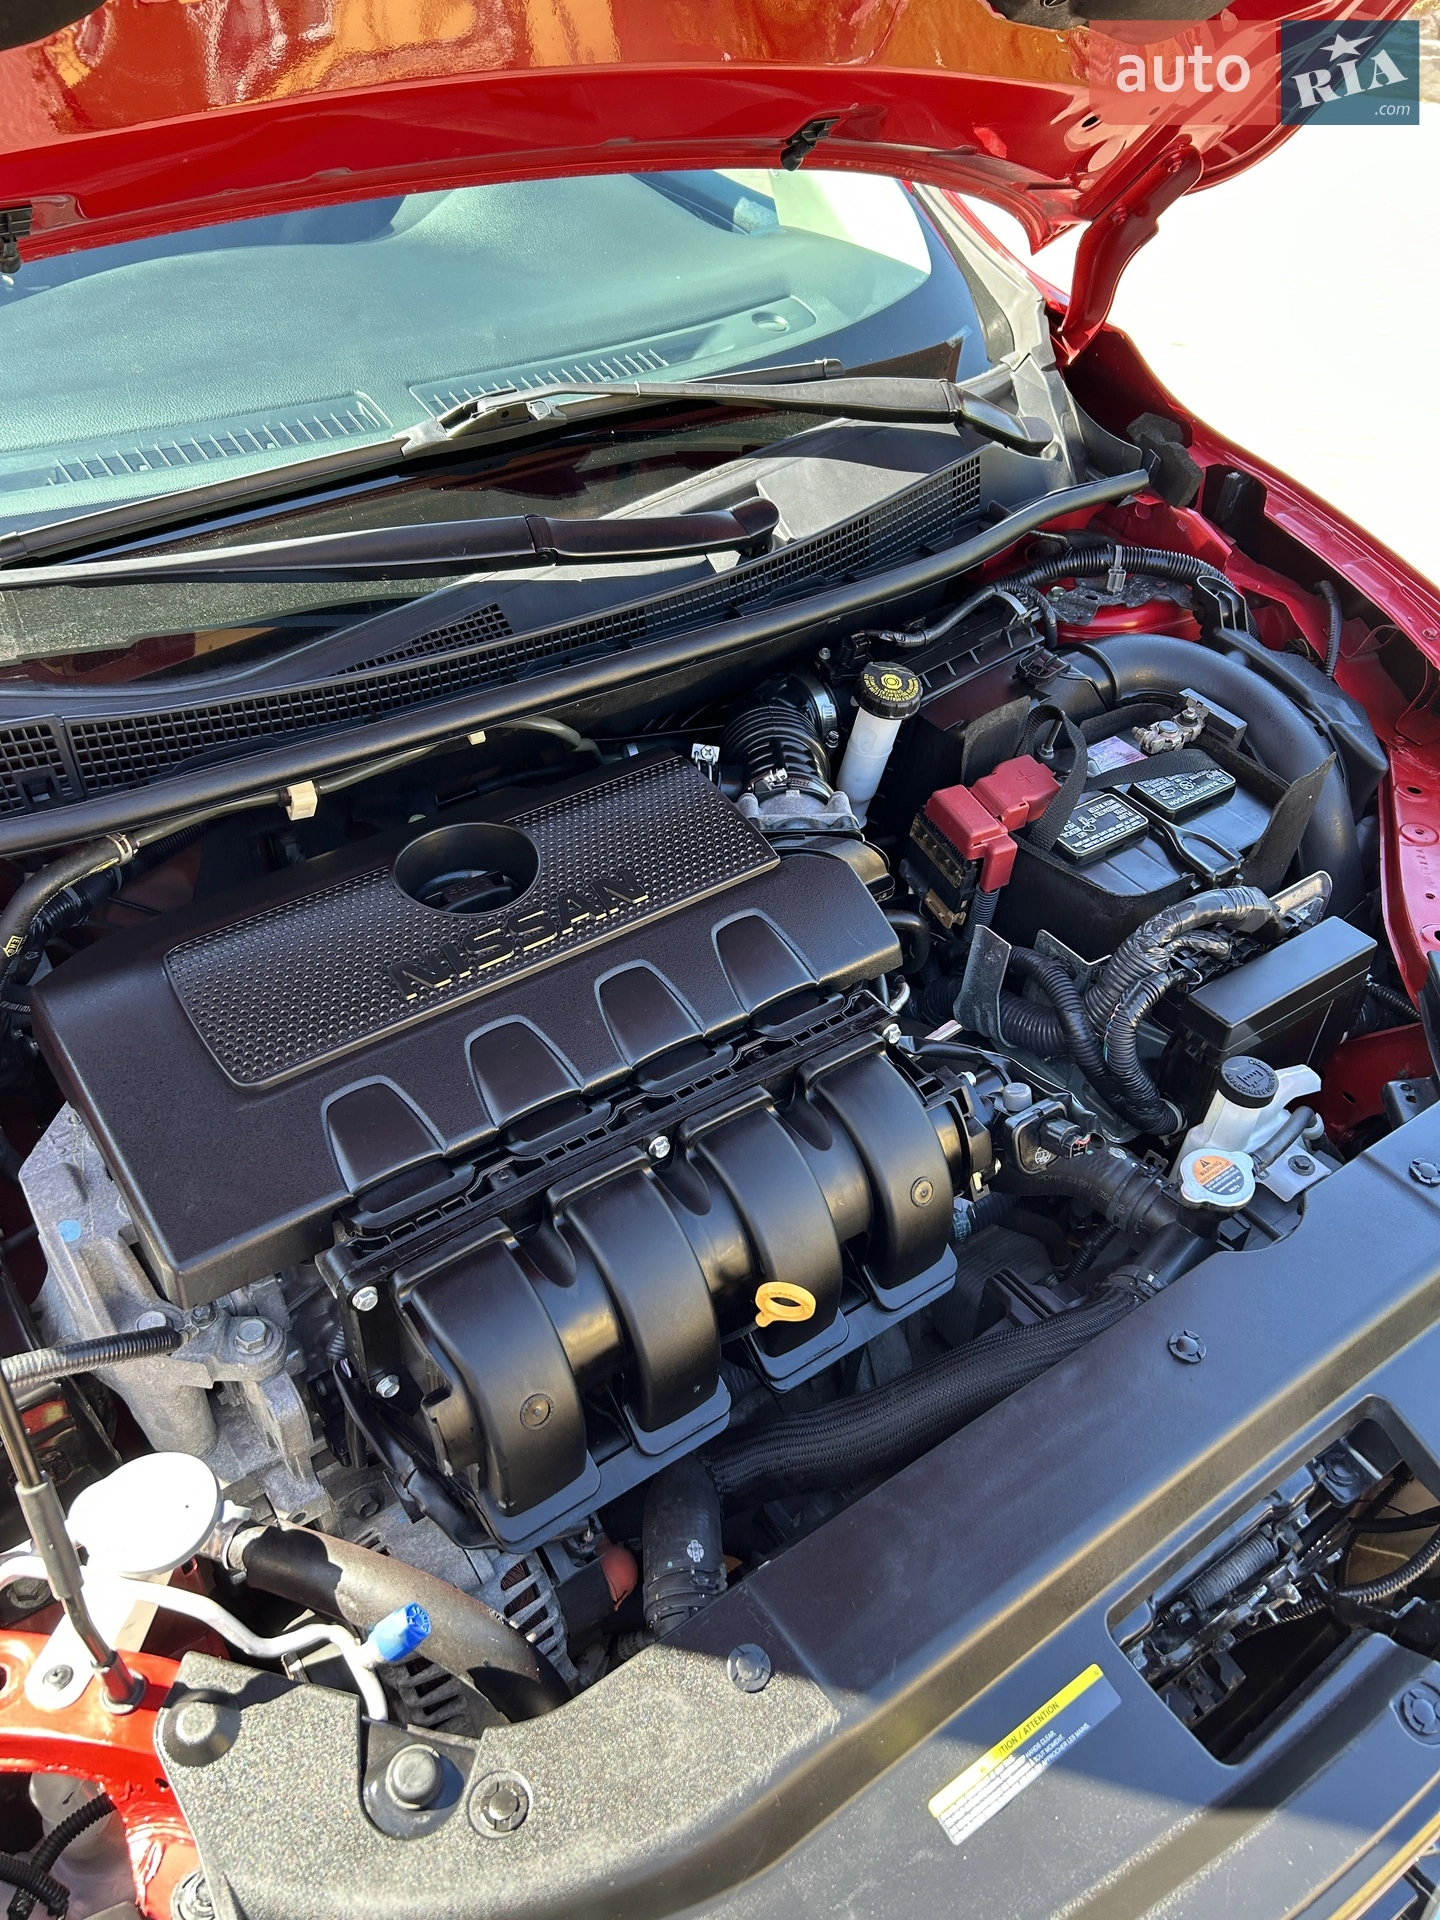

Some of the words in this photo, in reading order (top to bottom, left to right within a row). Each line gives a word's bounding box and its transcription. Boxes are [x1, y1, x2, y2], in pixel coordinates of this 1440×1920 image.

[387, 868, 649, 1000] NISSAN
[1199, 1160, 1222, 1176] WARNING
[1023, 1701, 1059, 1735] ATTENTION
[1025, 1741, 1041, 1758] HANDS
